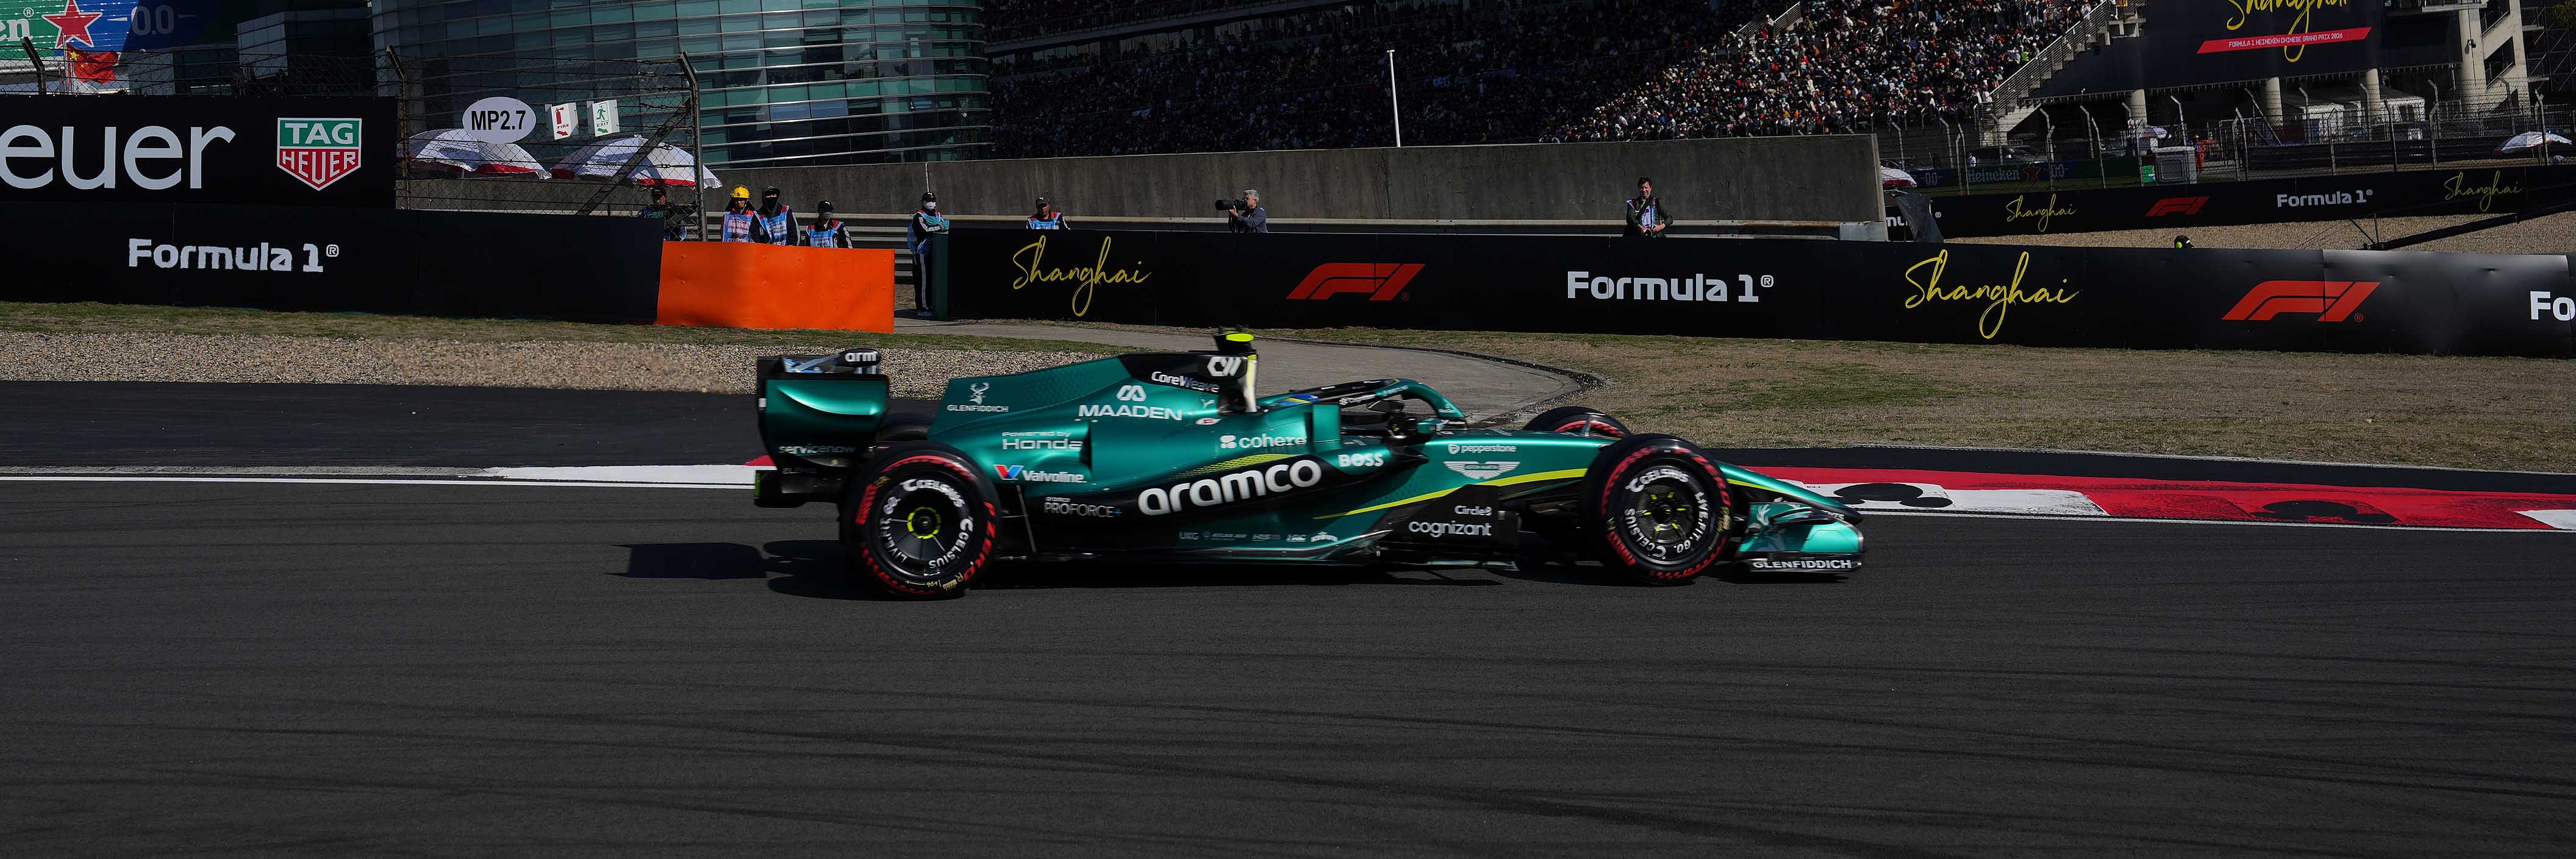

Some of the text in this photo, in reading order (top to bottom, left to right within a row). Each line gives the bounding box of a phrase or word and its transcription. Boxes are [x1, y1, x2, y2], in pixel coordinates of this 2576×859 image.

[470, 110, 527, 130] MP2.7
[285, 123, 354, 144] TAG
[281, 150, 357, 185] HEUER
[1968, 167, 2020, 183] Heineken
[2006, 193, 2077, 232] Shanghai
[2277, 191, 2352, 208] Formula
[2443, 171, 2524, 212] Shanghai
[129, 238, 293, 271] Formula
[1012, 235, 1152, 317] Shanghai
[1567, 271, 1728, 302] Formula
[1905, 249, 2080, 340] Shanghai
[2530, 291, 2576, 321] Fo
[844, 351, 878, 362] arm
[1151, 371, 1220, 393] CoreWeave
[946, 404, 1009, 413] GLENFIDDICH
[1078, 404, 1183, 421] MAADEN
[1002, 438, 1084, 450] Honda
[1239, 432, 1308, 449] cohere
[1461, 444, 1517, 454] pepperstone
[778, 444, 856, 455] servicenow
[1338, 453, 1385, 468] BOSS
[1137, 459, 1322, 516] aramco
[1408, 519, 1492, 538] cognizant
[1752, 559, 1852, 569] GLENFIDDICH
